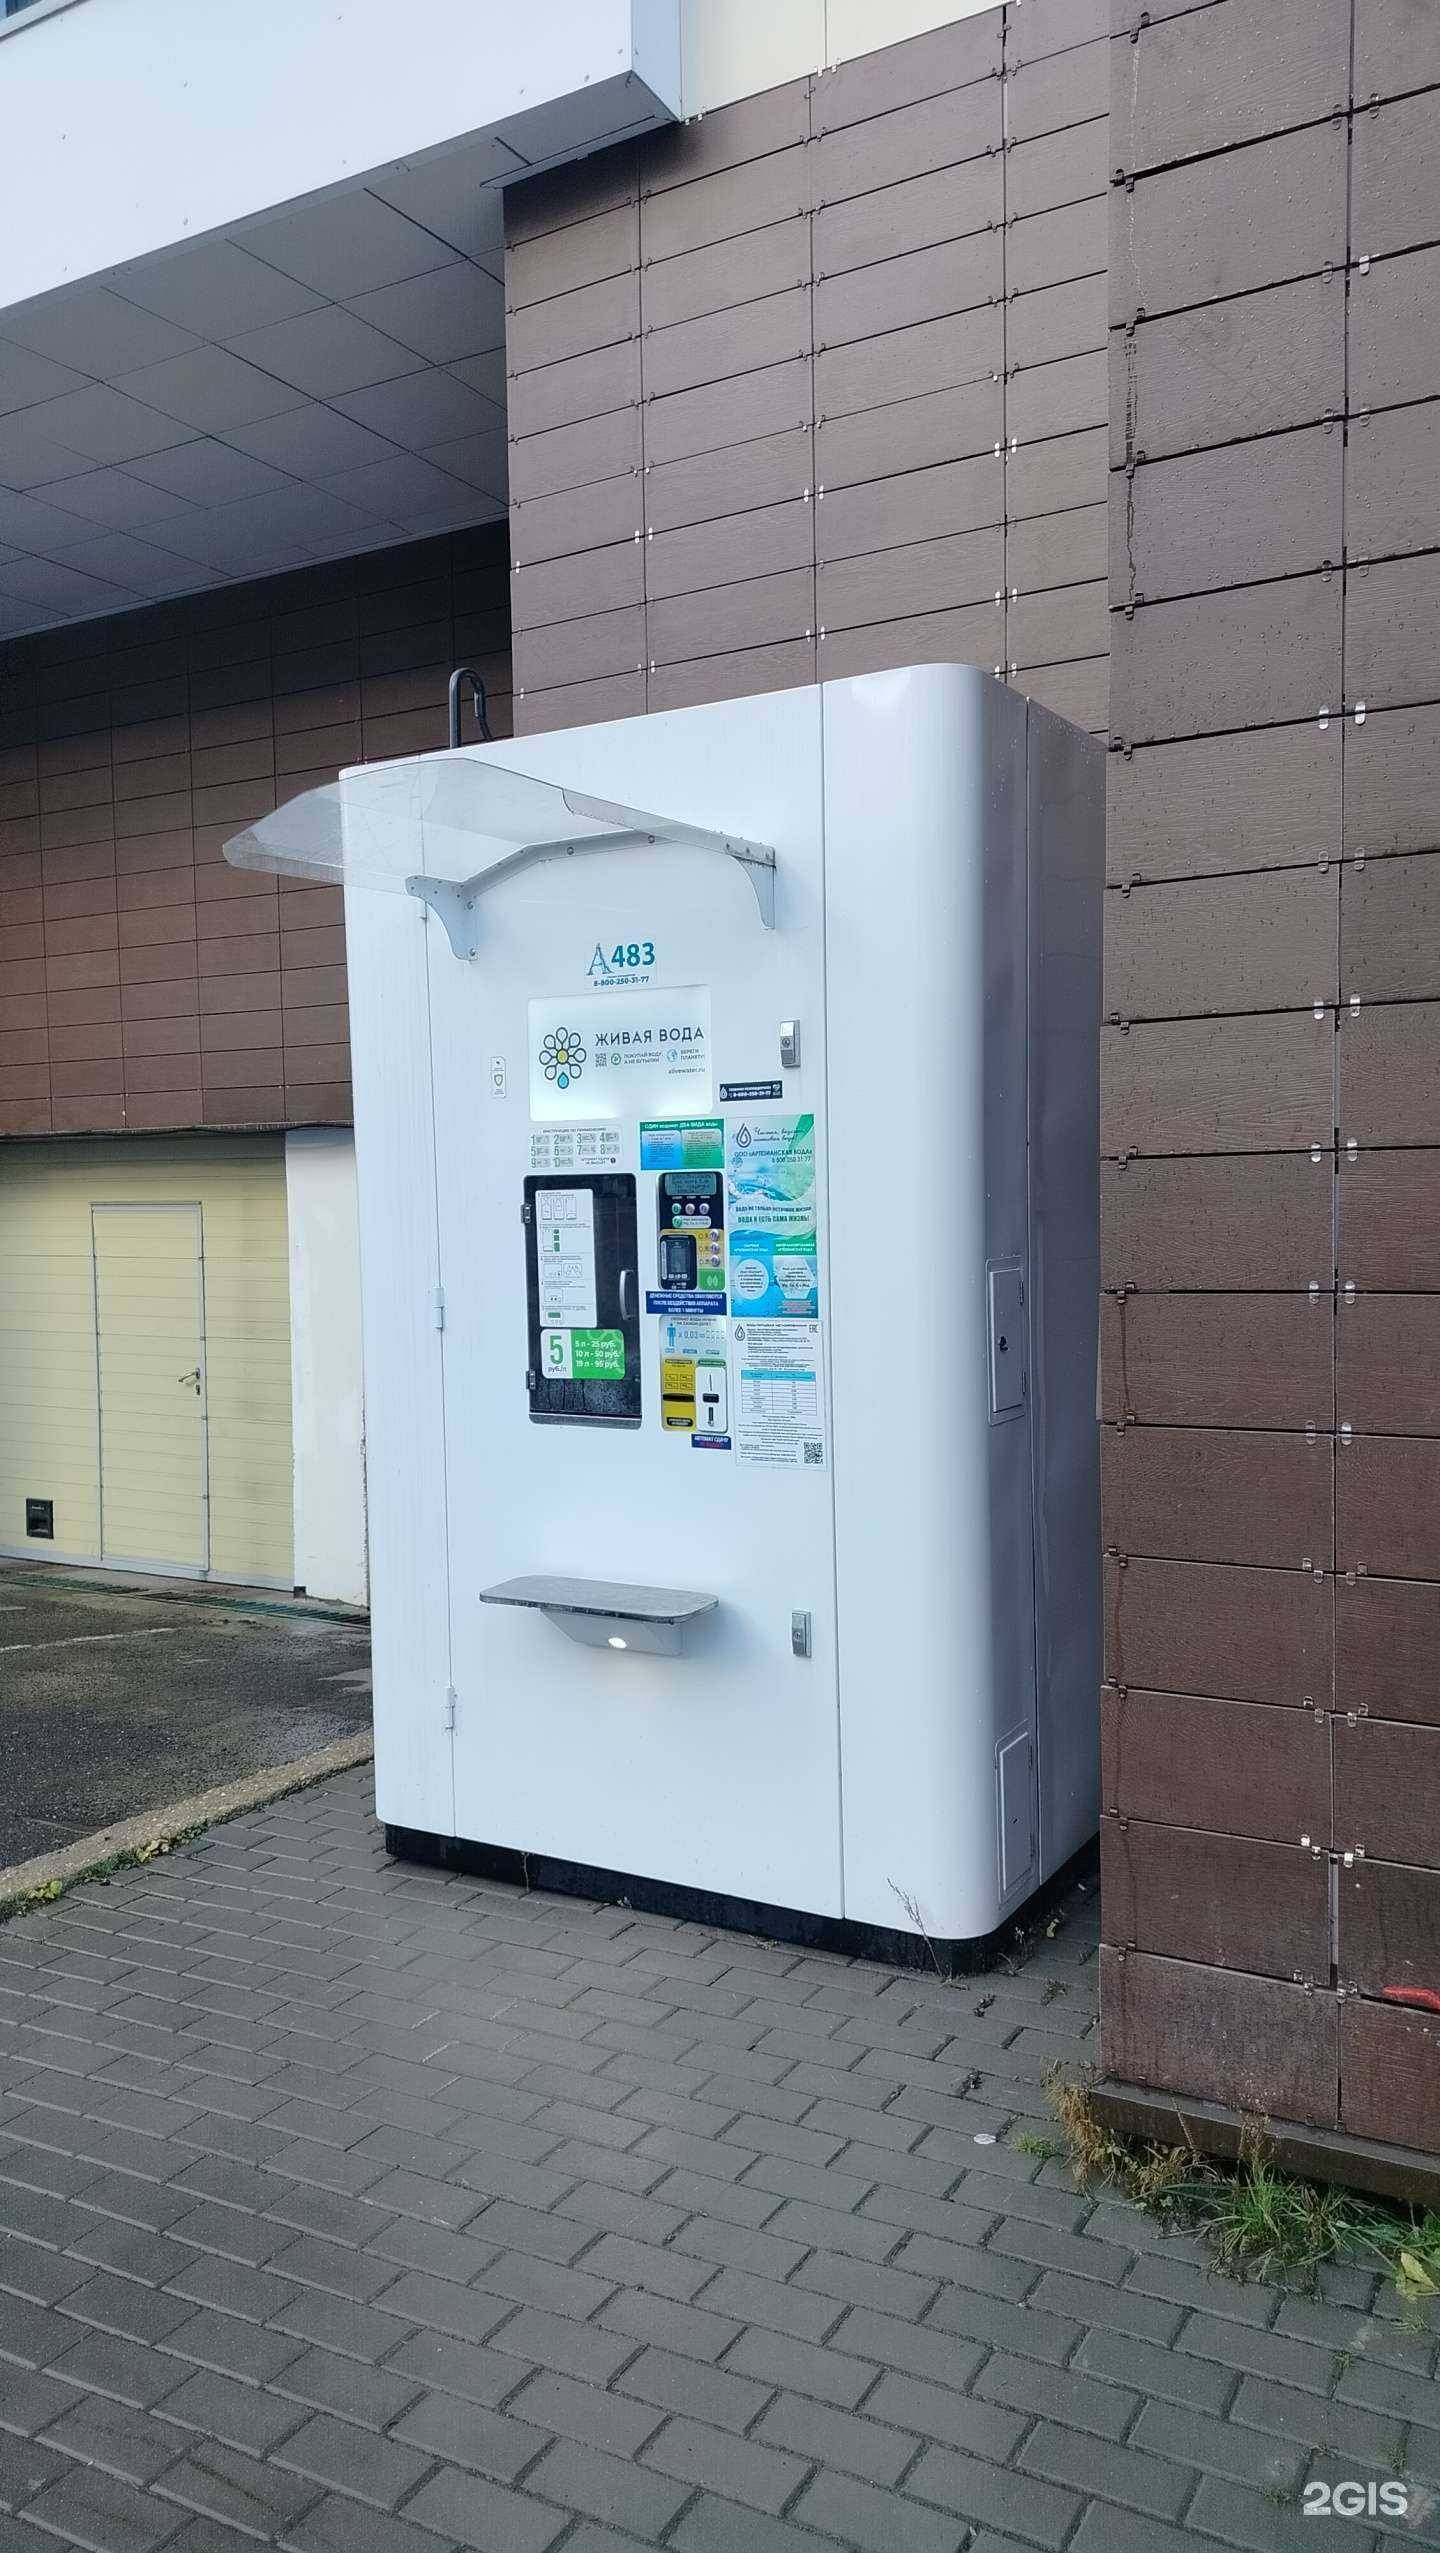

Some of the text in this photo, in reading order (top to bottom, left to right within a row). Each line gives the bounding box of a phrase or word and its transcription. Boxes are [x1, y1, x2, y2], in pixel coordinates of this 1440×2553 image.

[594, 1026, 704, 1046] ЖИВАЯ ВОДА
[530, 1135, 535, 1145] 1
[554, 1134, 559, 1144] 2
[576, 1133, 582, 1144] 3
[530, 1144, 605, 1156] 5 6 7 8
[530, 1158, 536, 1168] 9
[550, 1335, 563, 1364] 5
